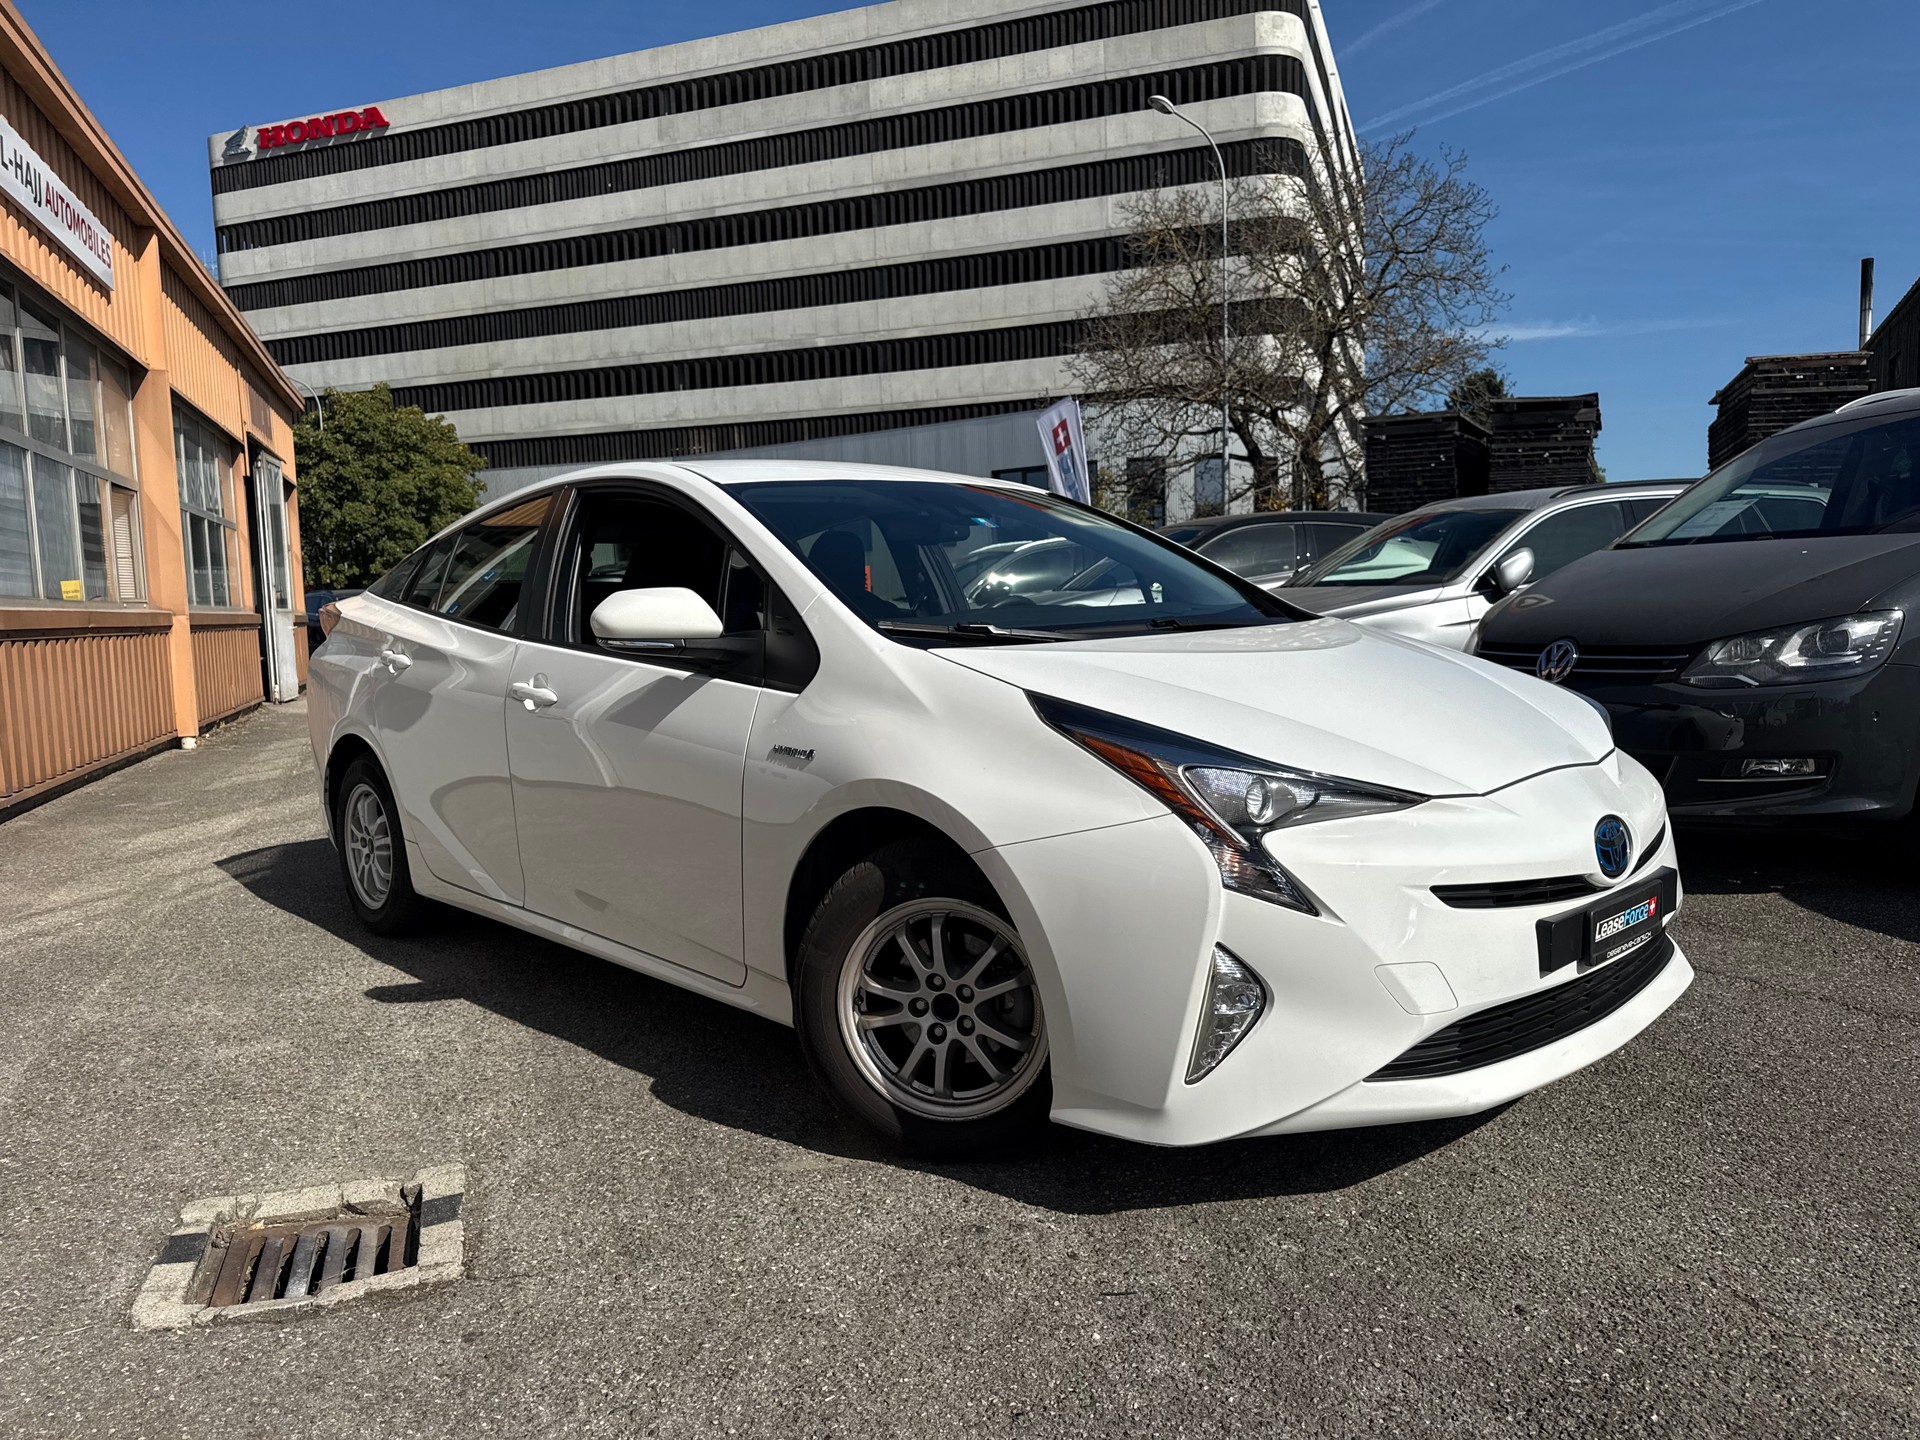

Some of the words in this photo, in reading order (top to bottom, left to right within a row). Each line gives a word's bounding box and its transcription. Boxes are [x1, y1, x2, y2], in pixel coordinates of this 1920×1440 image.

[257, 106, 390, 149] HONDA
[45, 181, 112, 269] AUTOMOBILES
[1595, 903, 1649, 940] LeaseForce
